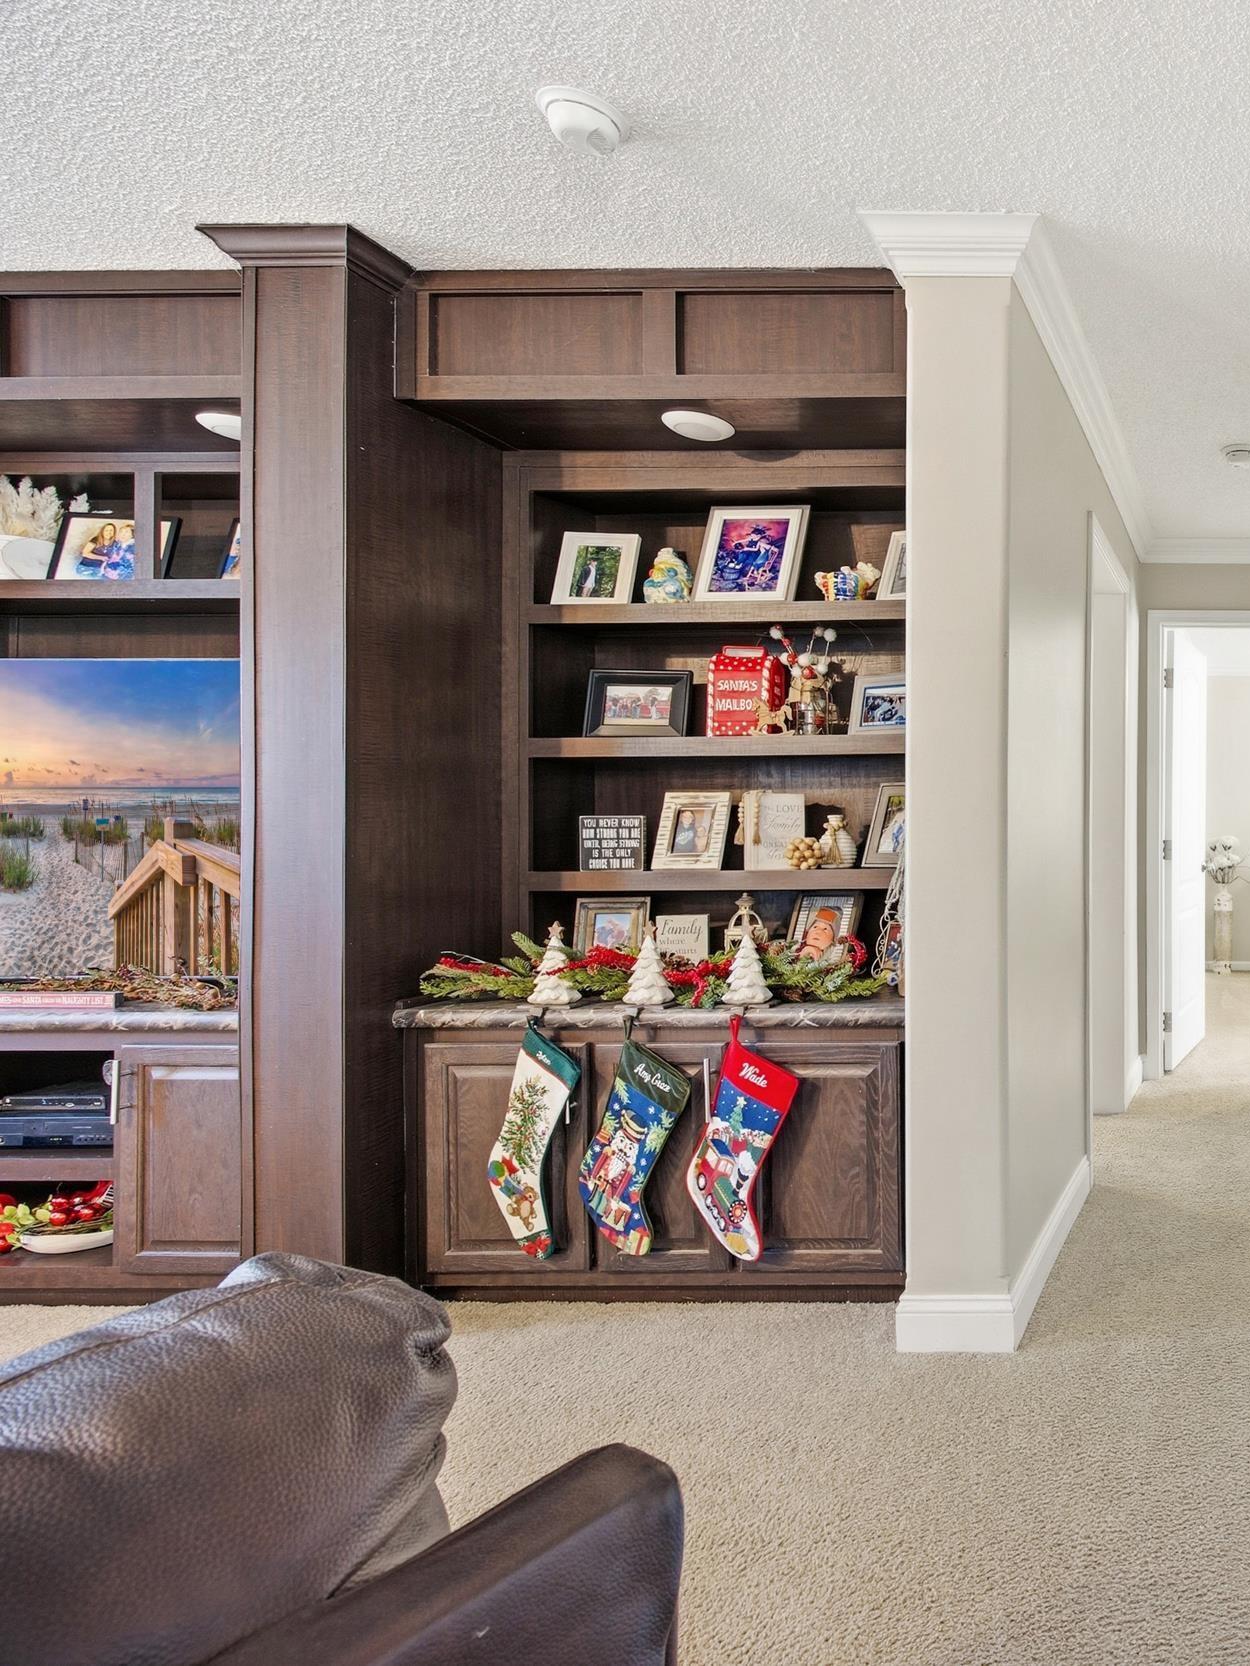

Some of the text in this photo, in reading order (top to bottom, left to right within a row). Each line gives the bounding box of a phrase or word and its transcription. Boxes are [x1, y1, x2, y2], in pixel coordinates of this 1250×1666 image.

[717, 679, 758, 691] SANTA'S
[715, 698, 754, 711] MAILBO
[583, 818, 640, 828] YOU NEVER KNOW
[592, 848, 632, 858] IS THE ONLY
[609, 858, 620, 869] YOU
[661, 918, 703, 943] Family
[633, 1063, 652, 1084] Amy
[738, 1062, 768, 1088] Wade
